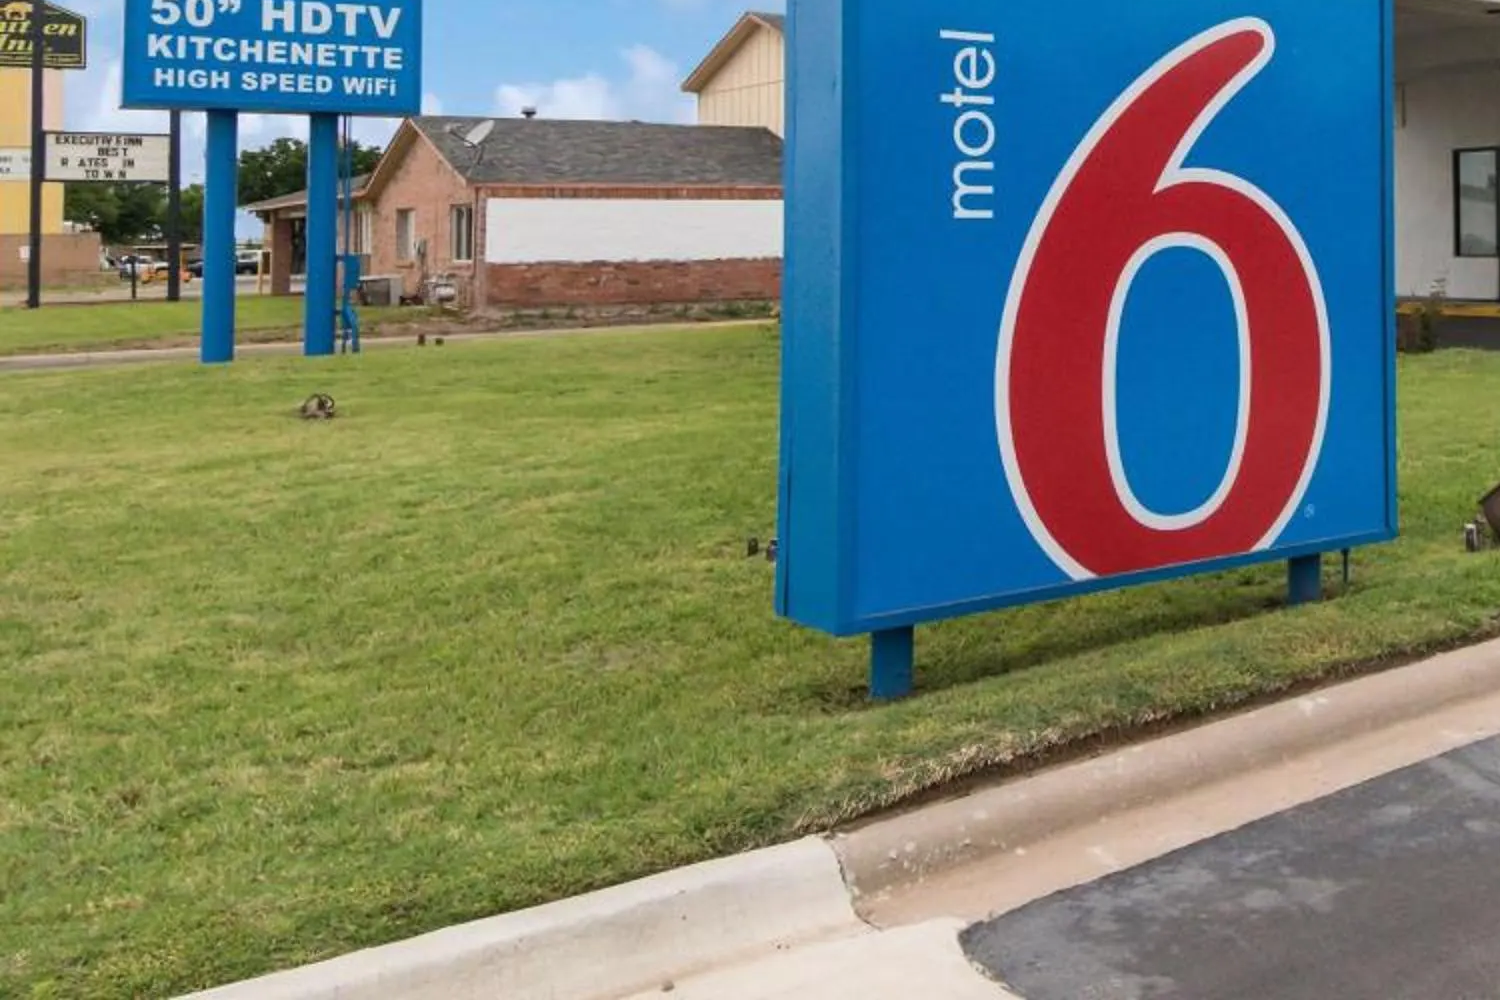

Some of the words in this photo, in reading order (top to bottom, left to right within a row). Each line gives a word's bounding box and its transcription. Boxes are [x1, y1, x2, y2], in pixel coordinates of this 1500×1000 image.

[147, 33, 403, 70] KITCHENETTE
[153, 67, 230, 89] HIGH
[241, 71, 333, 94] SPEED
[343, 76, 397, 97] WiFi
[939, 29, 995, 220] motel
[994, 16, 1332, 581] 6
